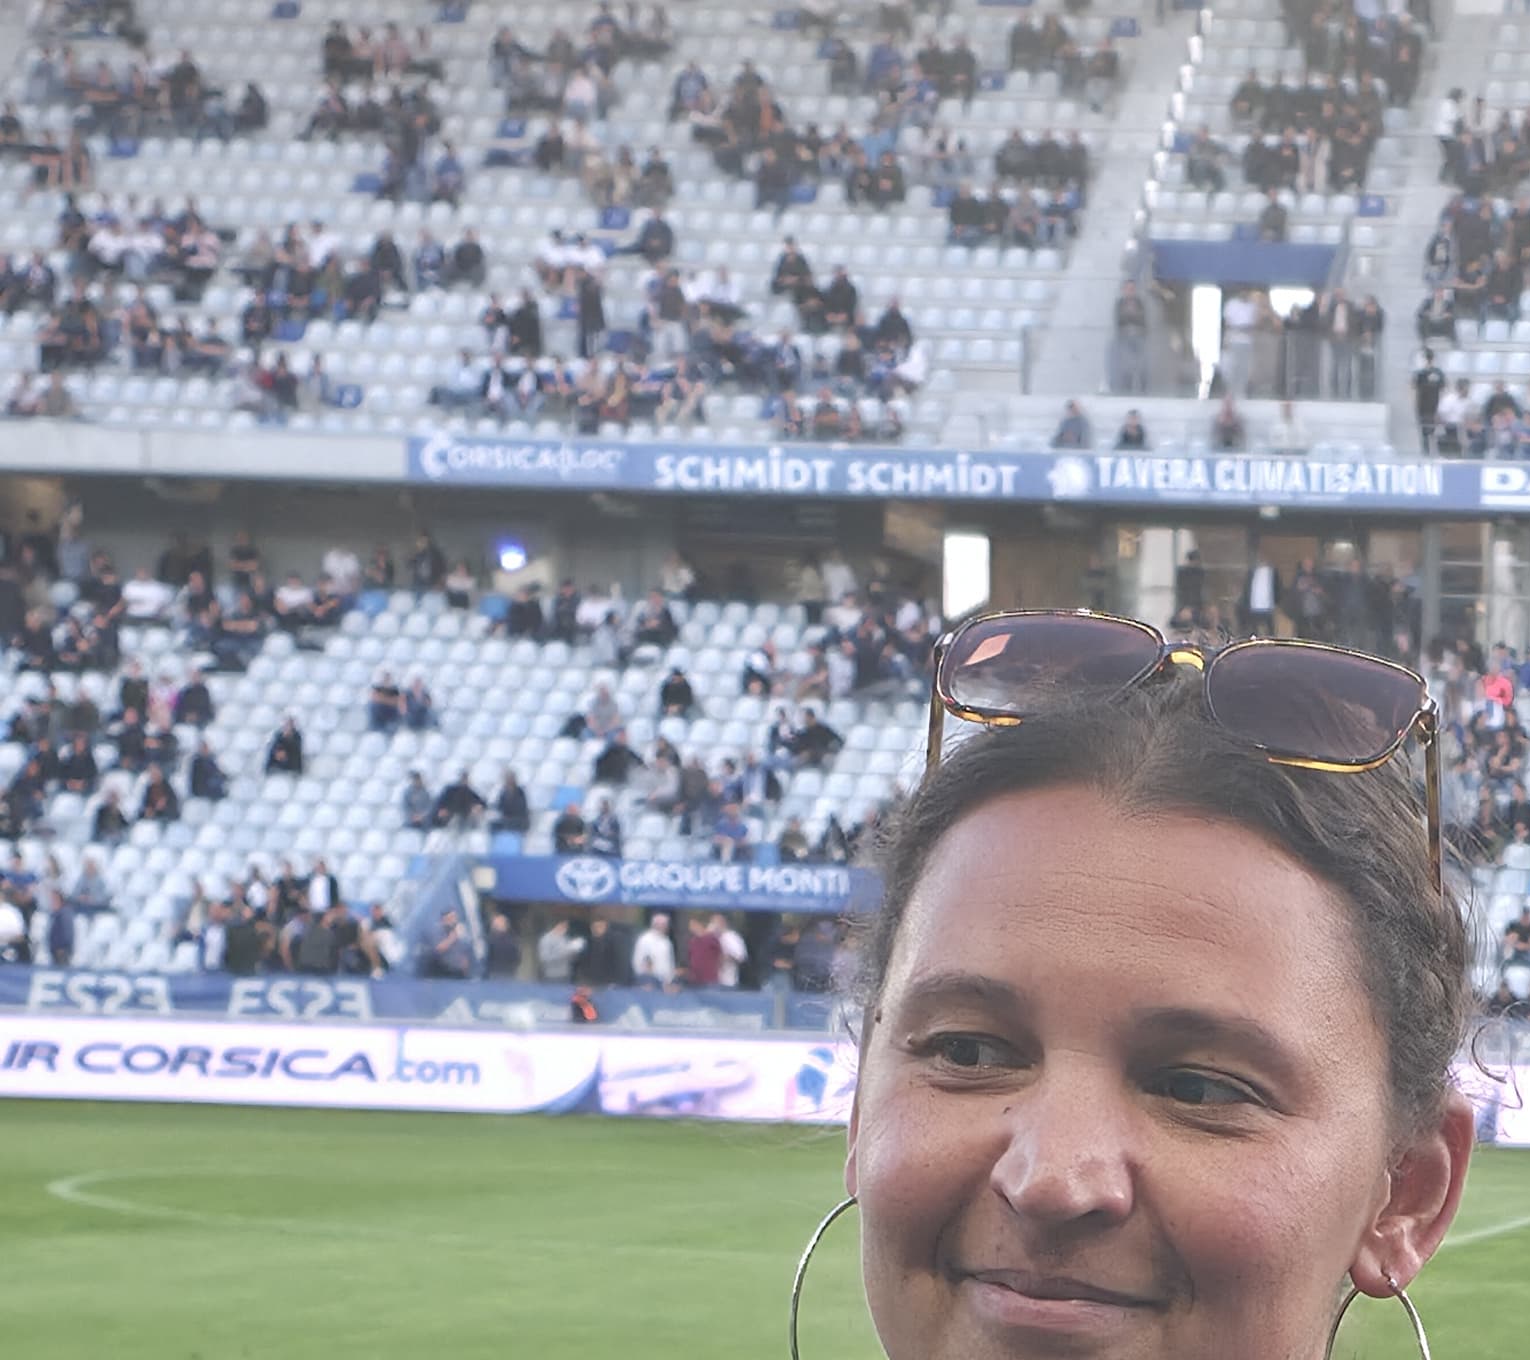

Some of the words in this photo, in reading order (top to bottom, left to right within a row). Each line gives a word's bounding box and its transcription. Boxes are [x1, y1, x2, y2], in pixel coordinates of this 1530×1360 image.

[654, 448, 834, 490] SCHMIDT
[847, 452, 1019, 496] SCHMIDT
[1214, 459, 1443, 496] CLIMATISATION
[619, 862, 743, 892] GROUPE
